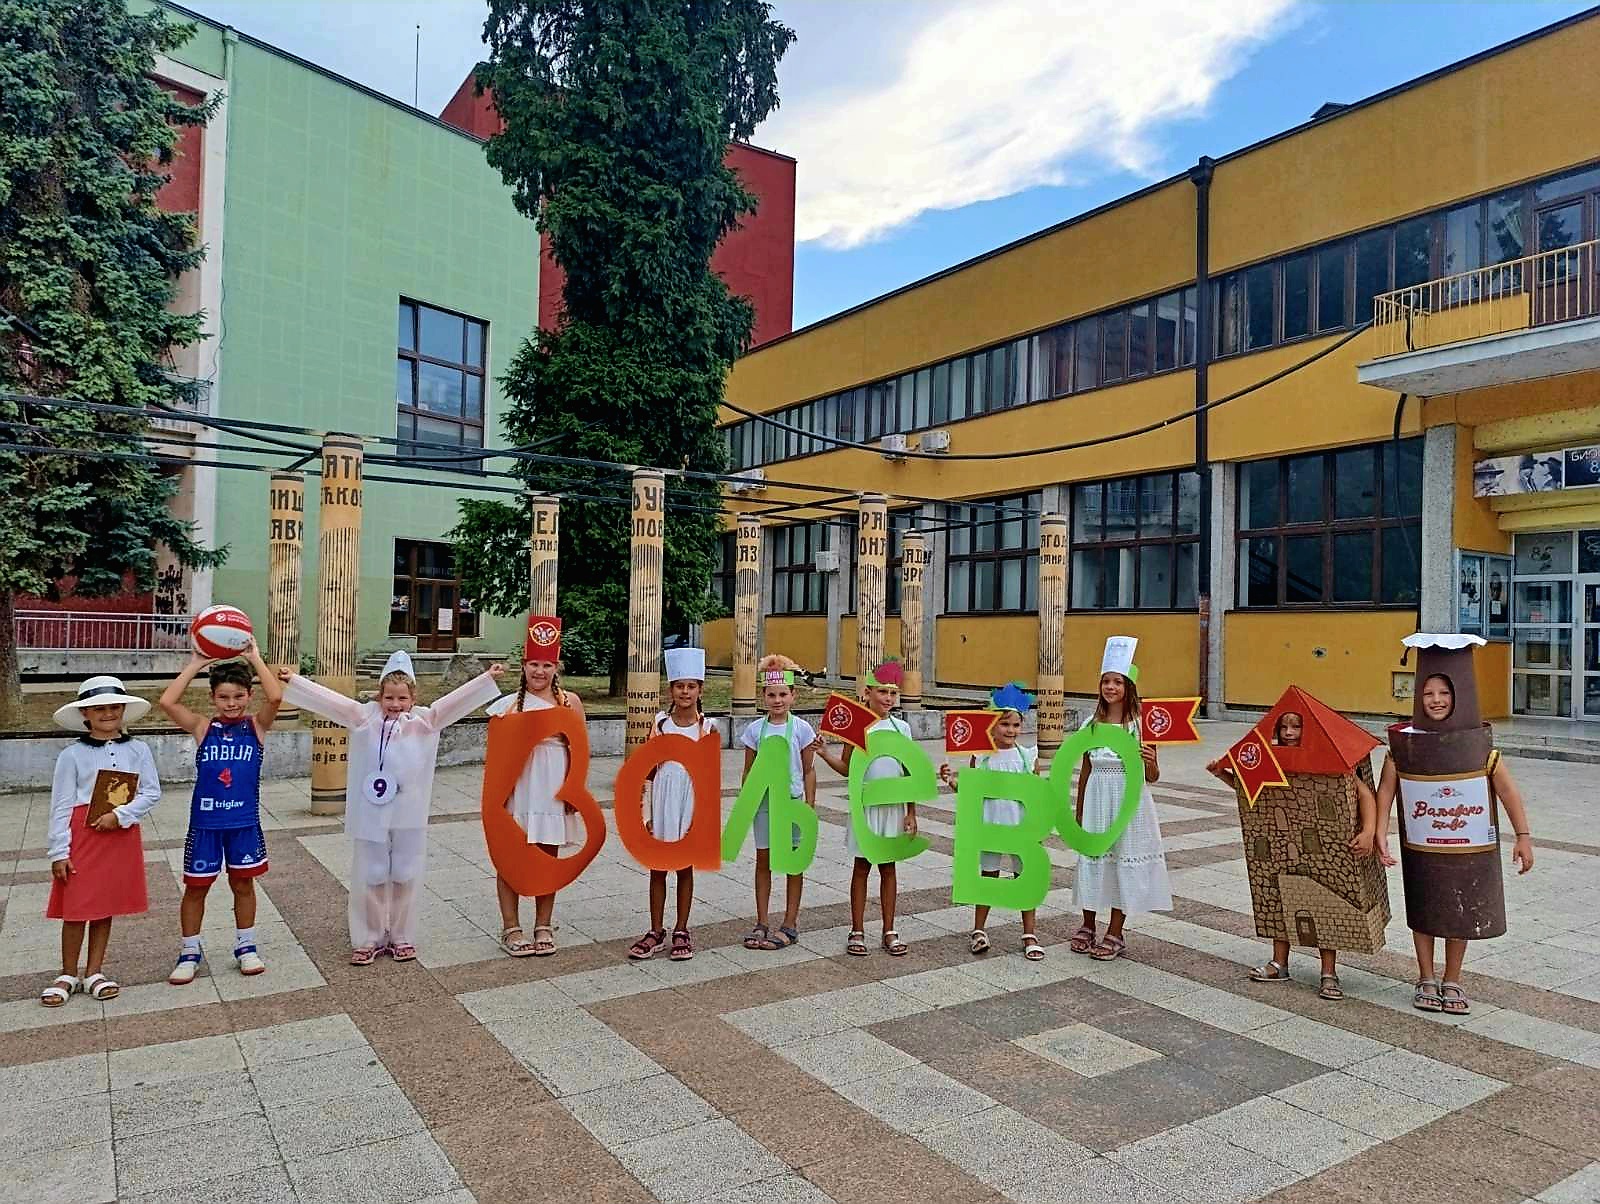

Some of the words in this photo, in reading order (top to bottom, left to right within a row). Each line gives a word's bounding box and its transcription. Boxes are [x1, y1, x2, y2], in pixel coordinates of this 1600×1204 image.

[201, 744, 254, 762] SRBIJA
[217, 767, 232, 789] 4
[373, 778, 387, 798] 9
[215, 799, 245, 811] triglav
